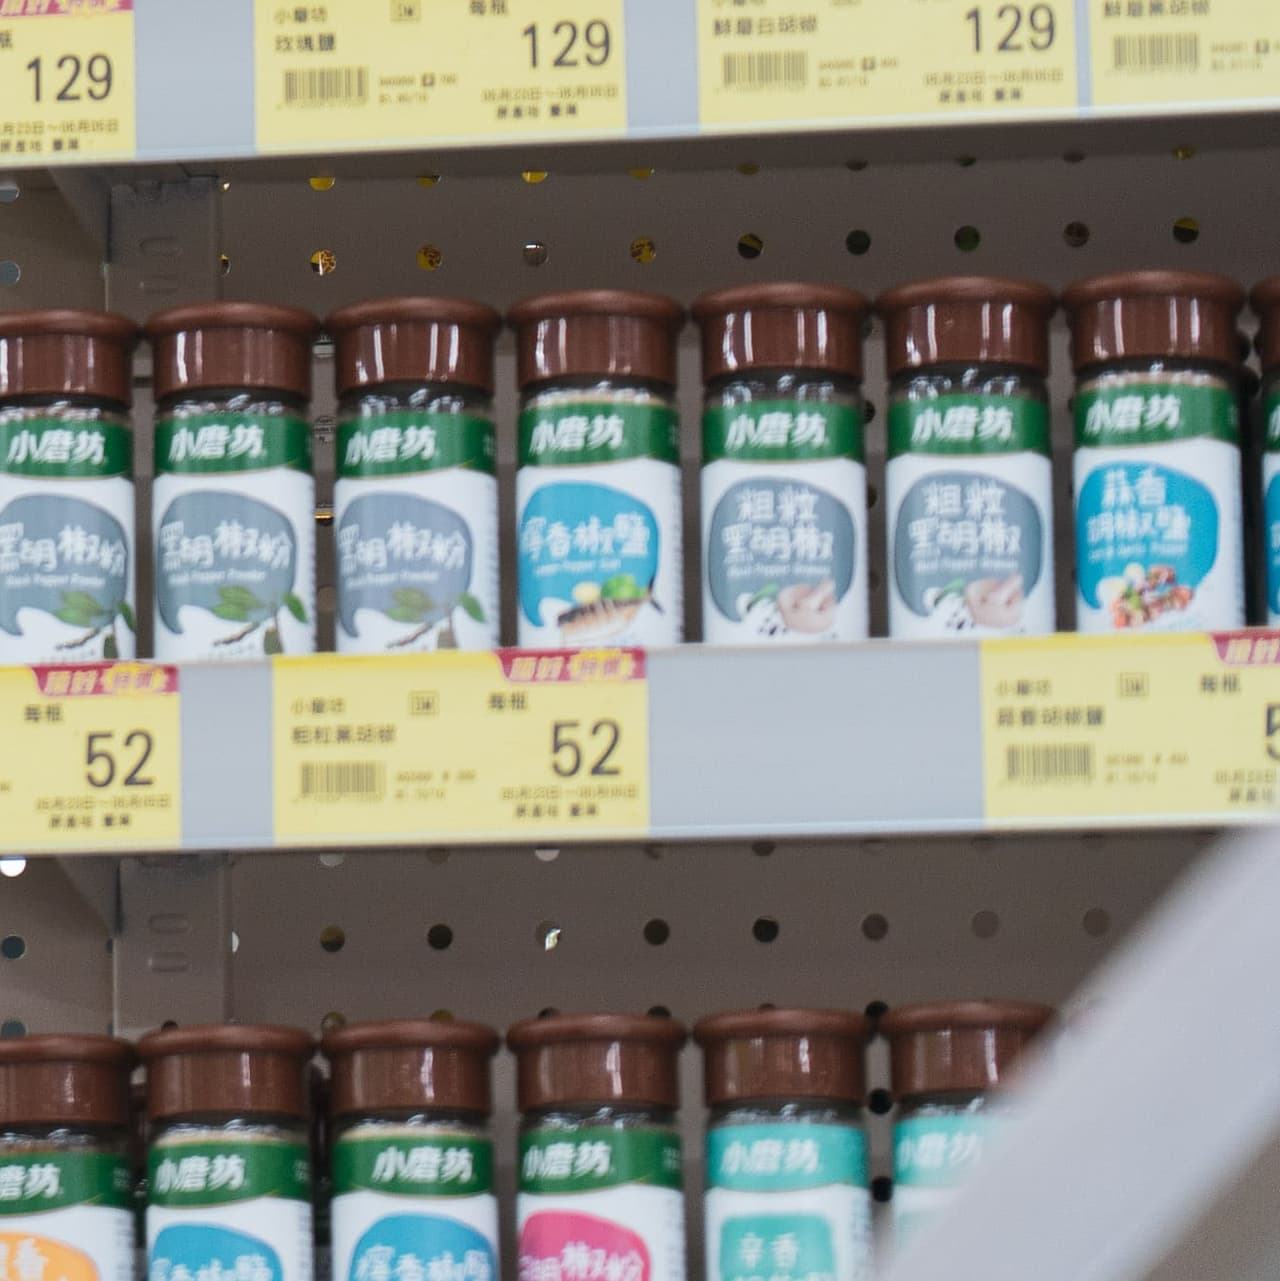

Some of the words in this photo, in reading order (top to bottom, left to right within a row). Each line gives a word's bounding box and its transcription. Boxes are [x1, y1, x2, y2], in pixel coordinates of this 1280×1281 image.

[522, 17, 612, 69] 129
[966, 2, 1057, 53] 129
[26, 53, 114, 103] 129
[530, 414, 624, 455] 小磨坊
[724, 411, 828, 451] 小磨坊
[912, 404, 1013, 443] 小磨坊
[1083, 394, 1181, 435] 小磨坊
[8, 429, 106, 464] 小磨坊
[169, 424, 264, 461] 小磨坊
[344, 425, 437, 466] 小磨坊
[721, 521, 834, 563] 黑胡椒
[908, 517, 1022, 556] 黑胡椒
[85, 728, 155, 788] 52
[550, 718, 621, 777] 52
[156, 1153, 246, 1194] 小磨坊
[371, 1145, 474, 1184] 小磨坊
[522, 1140, 612, 1180] 小磨坊
[720, 1138, 820, 1176] 小磨坊
